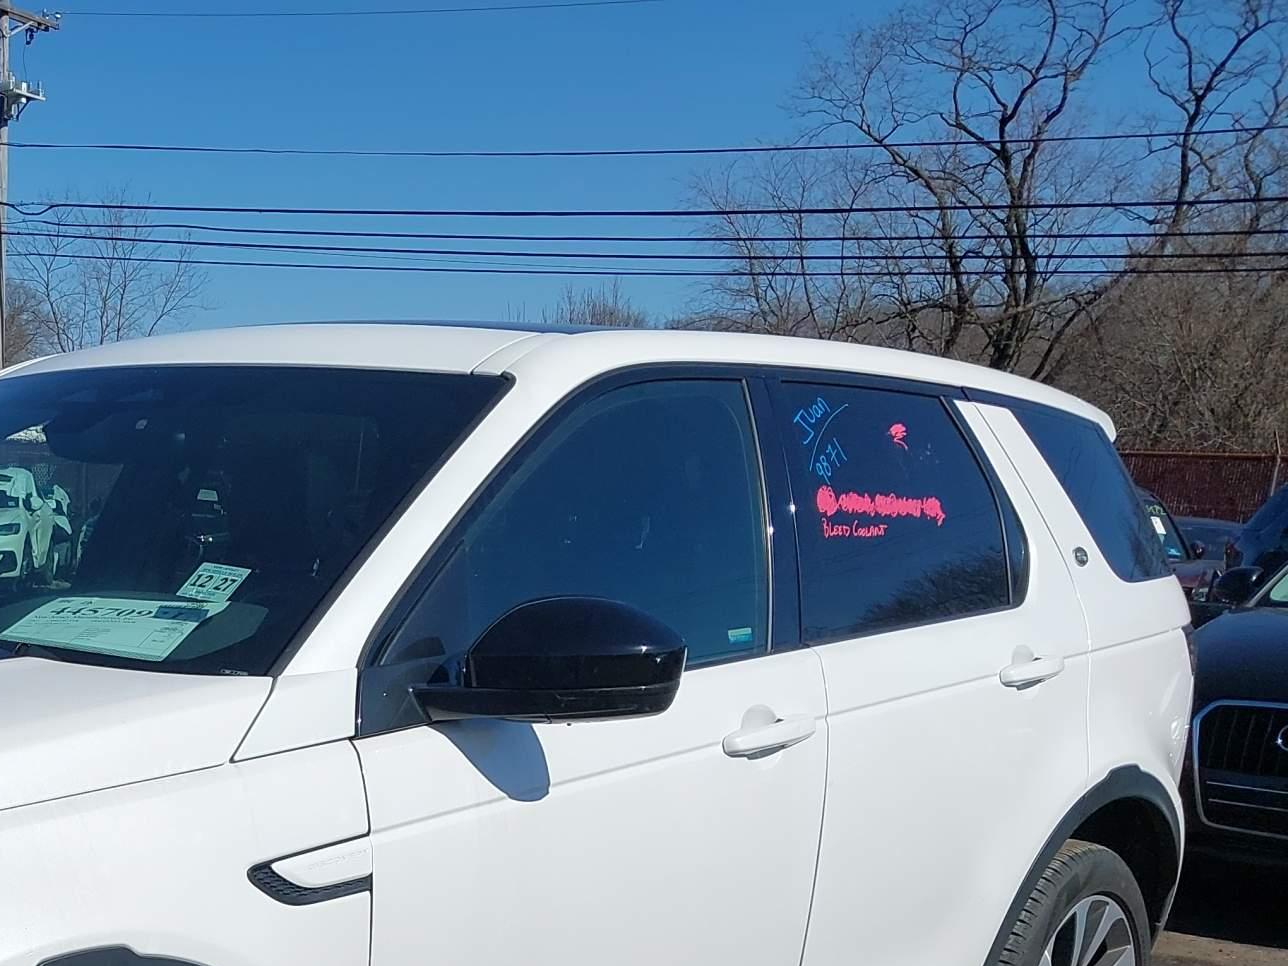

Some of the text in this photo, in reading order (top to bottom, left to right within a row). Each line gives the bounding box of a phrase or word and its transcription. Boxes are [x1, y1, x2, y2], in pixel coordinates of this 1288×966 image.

[793, 396, 830, 444] Juan
[815, 437, 848, 484] 9871
[189, 573, 239, 592] 12 27
[50, 606, 176, 618] 445709
